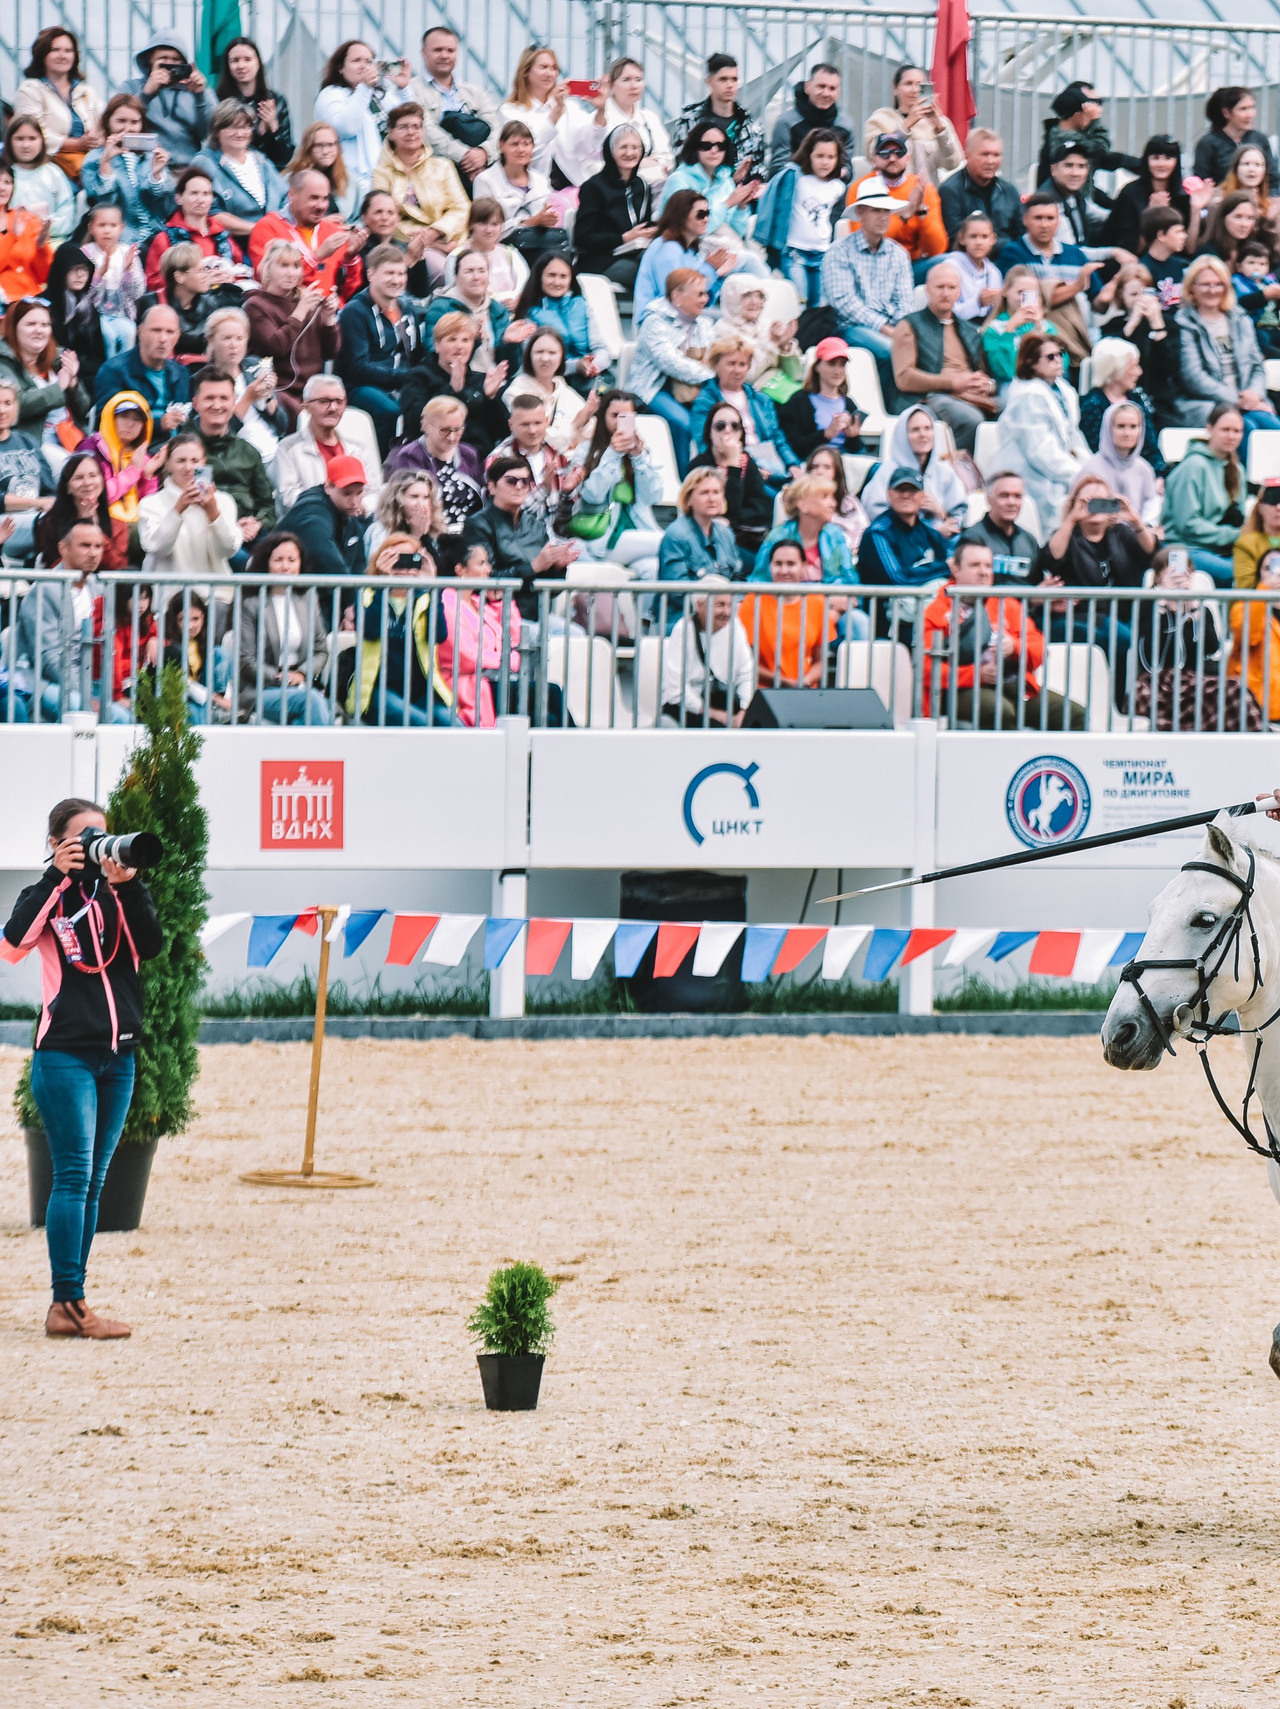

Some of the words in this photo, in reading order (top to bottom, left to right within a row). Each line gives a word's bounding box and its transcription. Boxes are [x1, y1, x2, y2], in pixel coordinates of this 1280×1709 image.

[1102, 759, 1167, 769] ЧЕМПИОНАТ
[1123, 771, 1175, 786] МИРА
[1103, 789, 1118, 799] ПО
[1120, 789, 1191, 800] ДЖИГИТОВКЕ
[271, 820, 334, 840] ВДНХ
[712, 820, 764, 837] ЦНКТ
